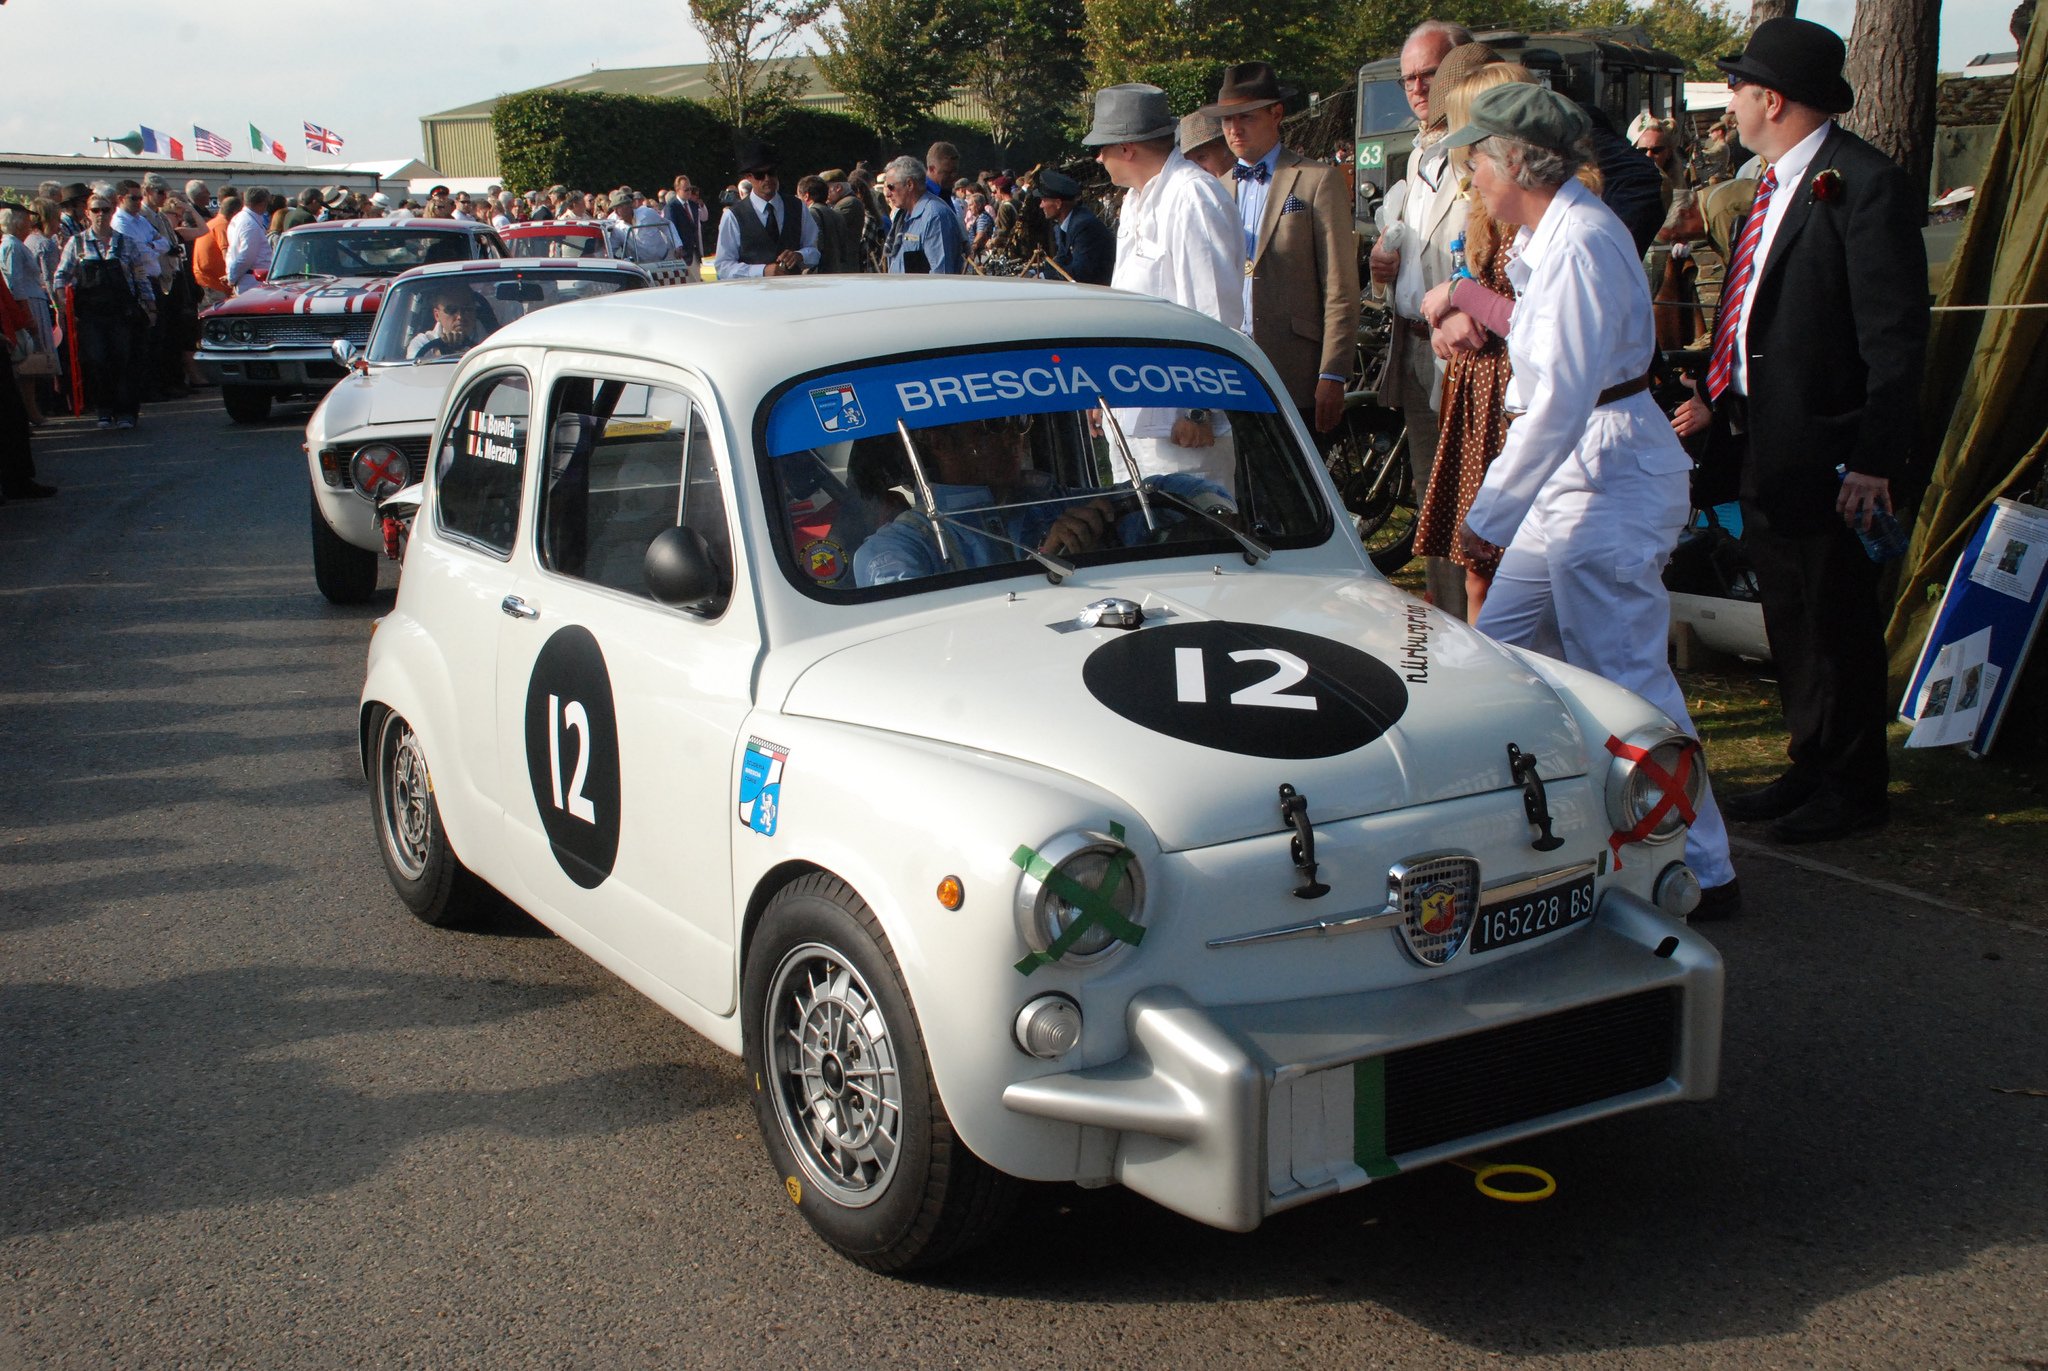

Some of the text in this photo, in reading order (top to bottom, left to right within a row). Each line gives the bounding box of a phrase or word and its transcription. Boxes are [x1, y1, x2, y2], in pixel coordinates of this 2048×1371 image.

[1360, 145, 1382, 165] 63
[896, 360, 1247, 412] BRESCIA CORSE
[475, 435, 517, 465] A. Merzario
[478, 411, 515, 438] M. Borella
[1175, 648, 1318, 711] 12
[549, 693, 596, 825] 12
[1483, 884, 1593, 945] 165228 BS
